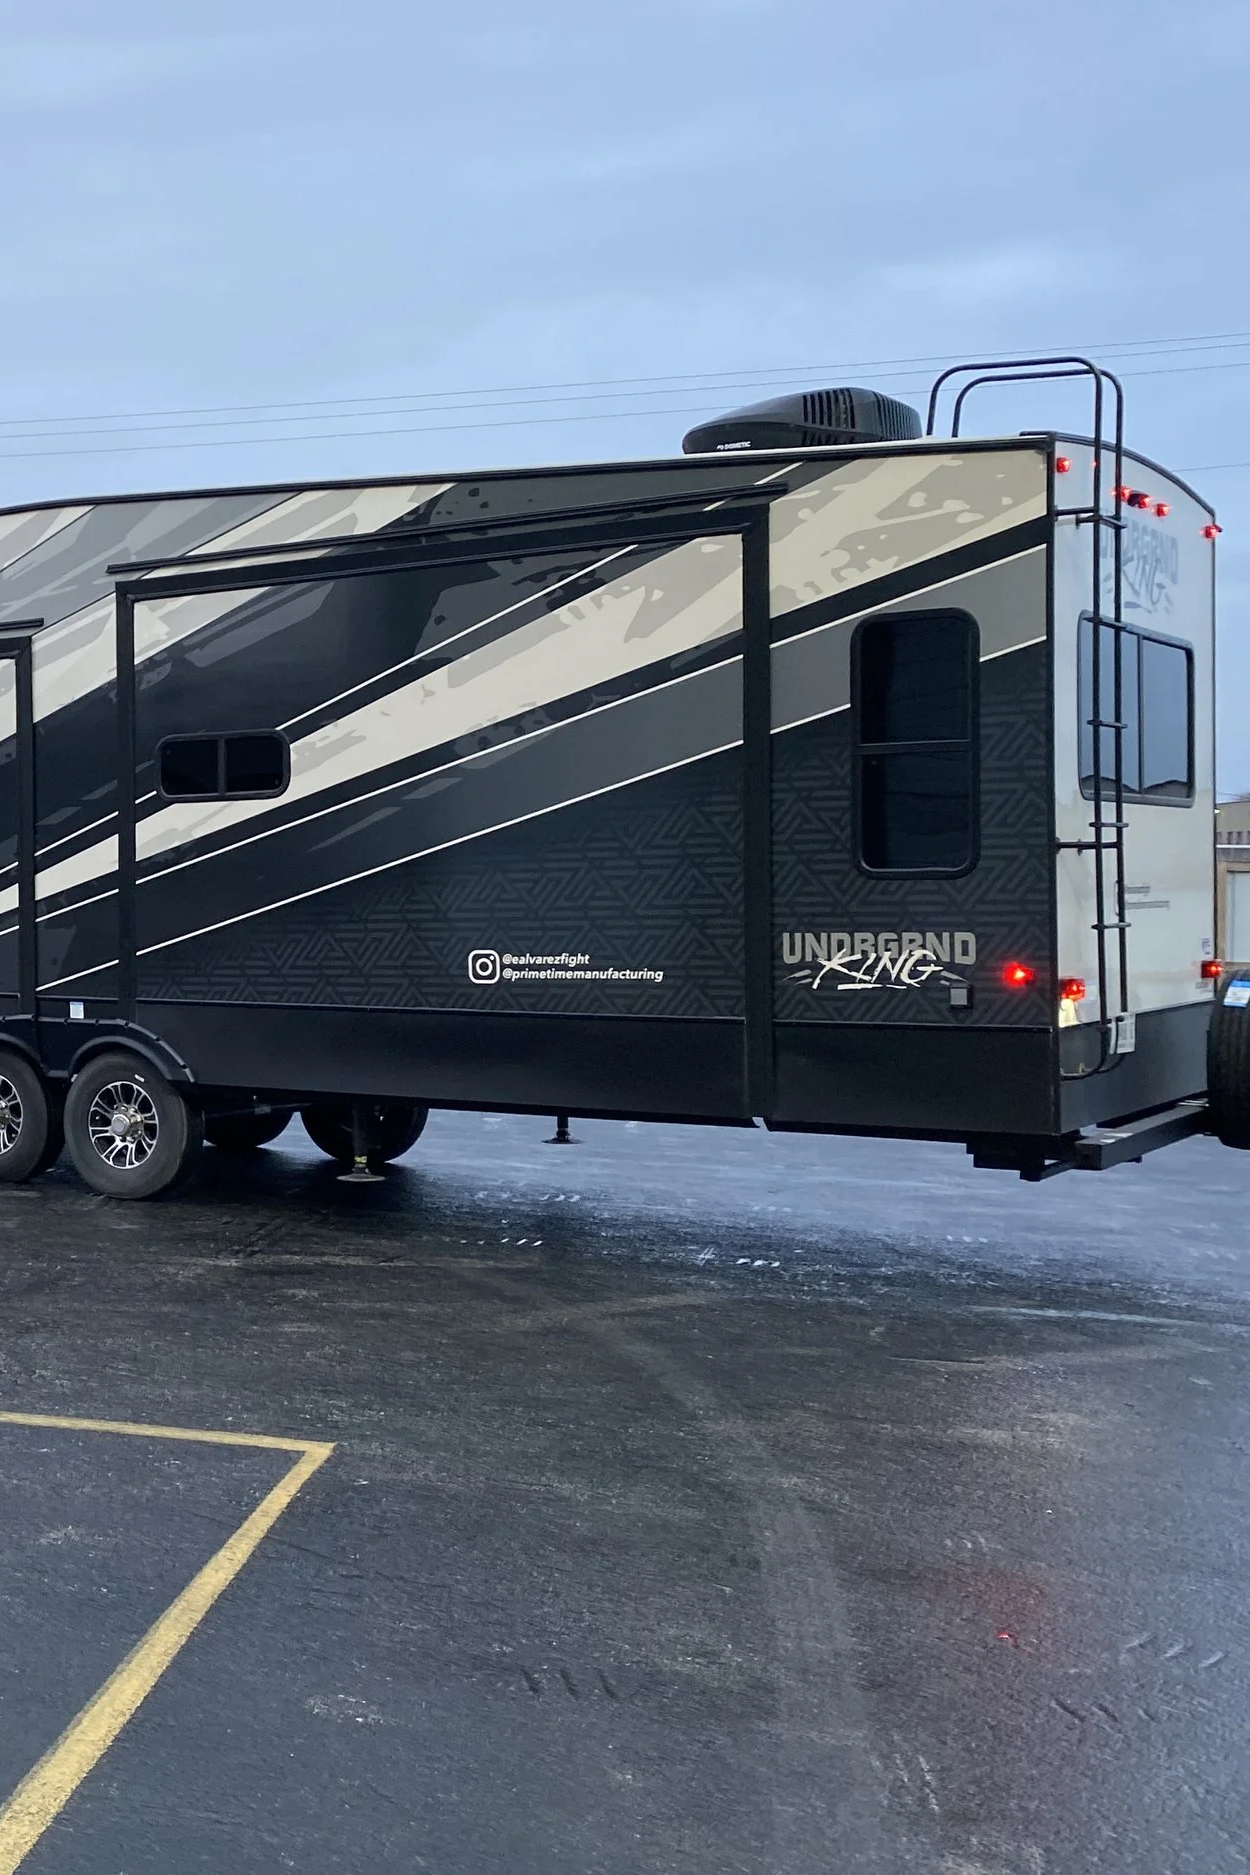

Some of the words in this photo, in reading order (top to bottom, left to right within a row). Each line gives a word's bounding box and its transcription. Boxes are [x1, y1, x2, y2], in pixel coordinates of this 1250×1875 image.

[724, 441, 751, 450] DOMETIC
[782, 931, 977, 965] UNDRGRND
[502, 953, 590, 967] @ealvarezfight
[502, 968, 664, 982] @primetimemanufacturing
[812, 948, 944, 990] KING
